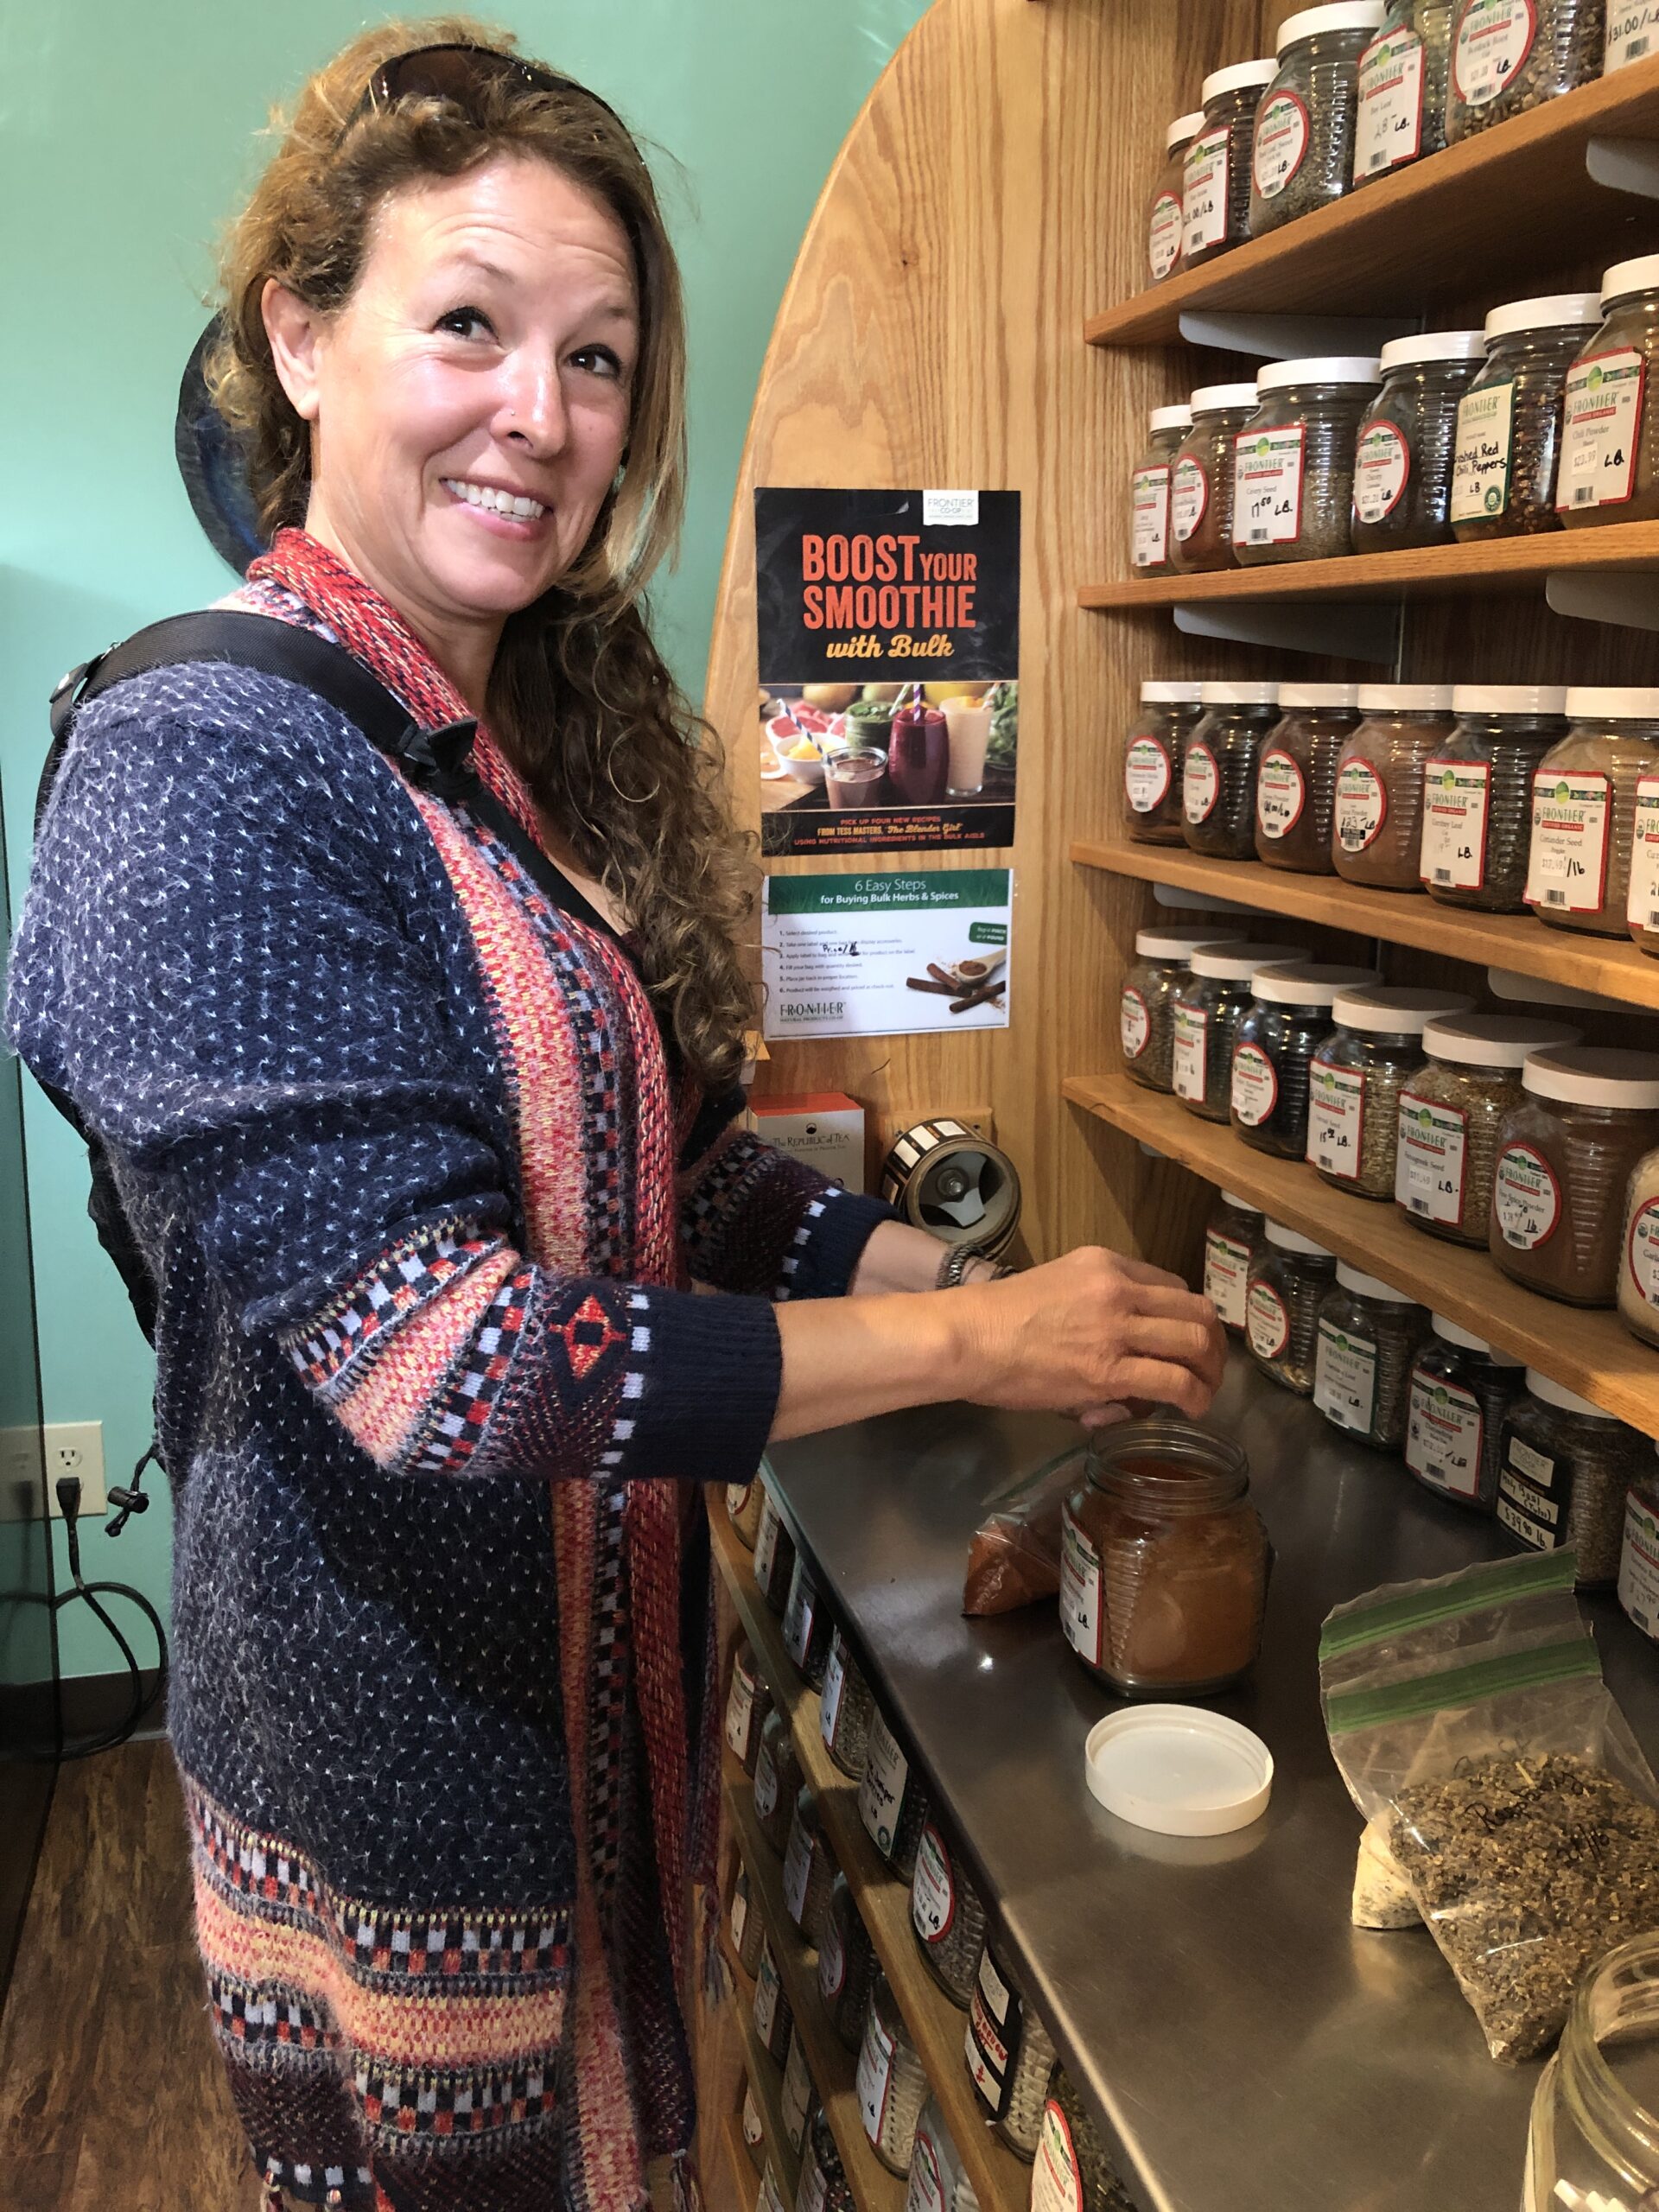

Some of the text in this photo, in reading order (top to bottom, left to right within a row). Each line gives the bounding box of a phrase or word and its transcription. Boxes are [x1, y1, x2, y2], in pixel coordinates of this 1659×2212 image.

[1463, 395, 1500, 418] FRONTIER
[1573, 391, 1619, 415] FRONTIER
[1481, 441, 1499, 457] Red
[1245, 458, 1285, 472] FRONTIER
[1471, 458, 1508, 475] Peppers
[1470, 481, 1480, 493] LB
[928, 498, 974, 508] FRONTIER
[802, 534, 977, 582] BOOST YOUR
[803, 585, 976, 630] SMOOTHIE
[826, 634, 955, 658] with Bulk
[1433, 793, 1468, 807] FRONTIER
[1542, 806, 1586, 823] FRONTIER
[817, 828, 836, 836] FROM
[836, 827, 852, 836] TESS
[1567, 837, 1582, 847] Seed
[855, 878, 927, 895] 6 Easy Steps
[821, 891, 959, 906] for Buying Bulk Herbs & Spices
[780, 1002, 846, 1016] FRONTIER
[1407, 1125, 1447, 1147] FRONTIER
[1430, 1160, 1446, 1172] Seed
[1505, 1166, 1542, 1189] FRONTIER
